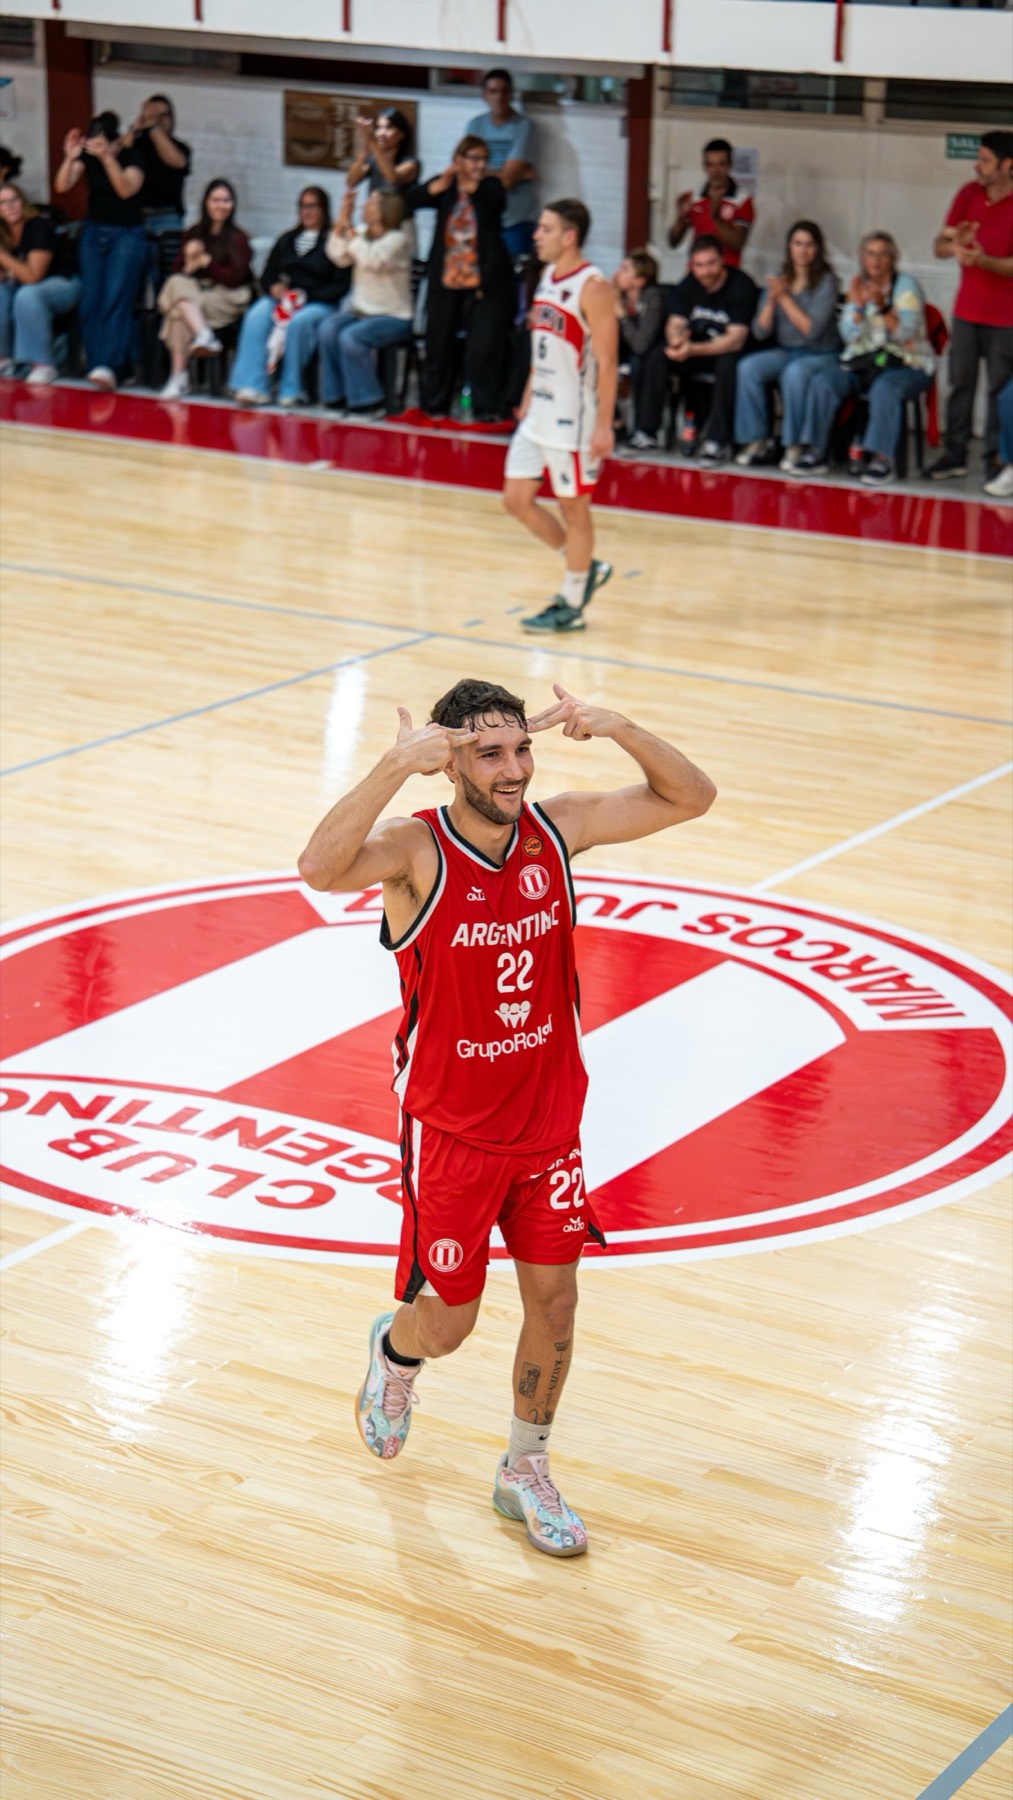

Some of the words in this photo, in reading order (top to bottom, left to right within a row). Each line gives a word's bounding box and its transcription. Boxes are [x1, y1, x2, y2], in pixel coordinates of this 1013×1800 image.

[496, 949, 534, 993] 22
[681, 912, 965, 1020] MARCOS
[47, 1128, 336, 1209] CLUB
[549, 1166, 585, 1210] 22
